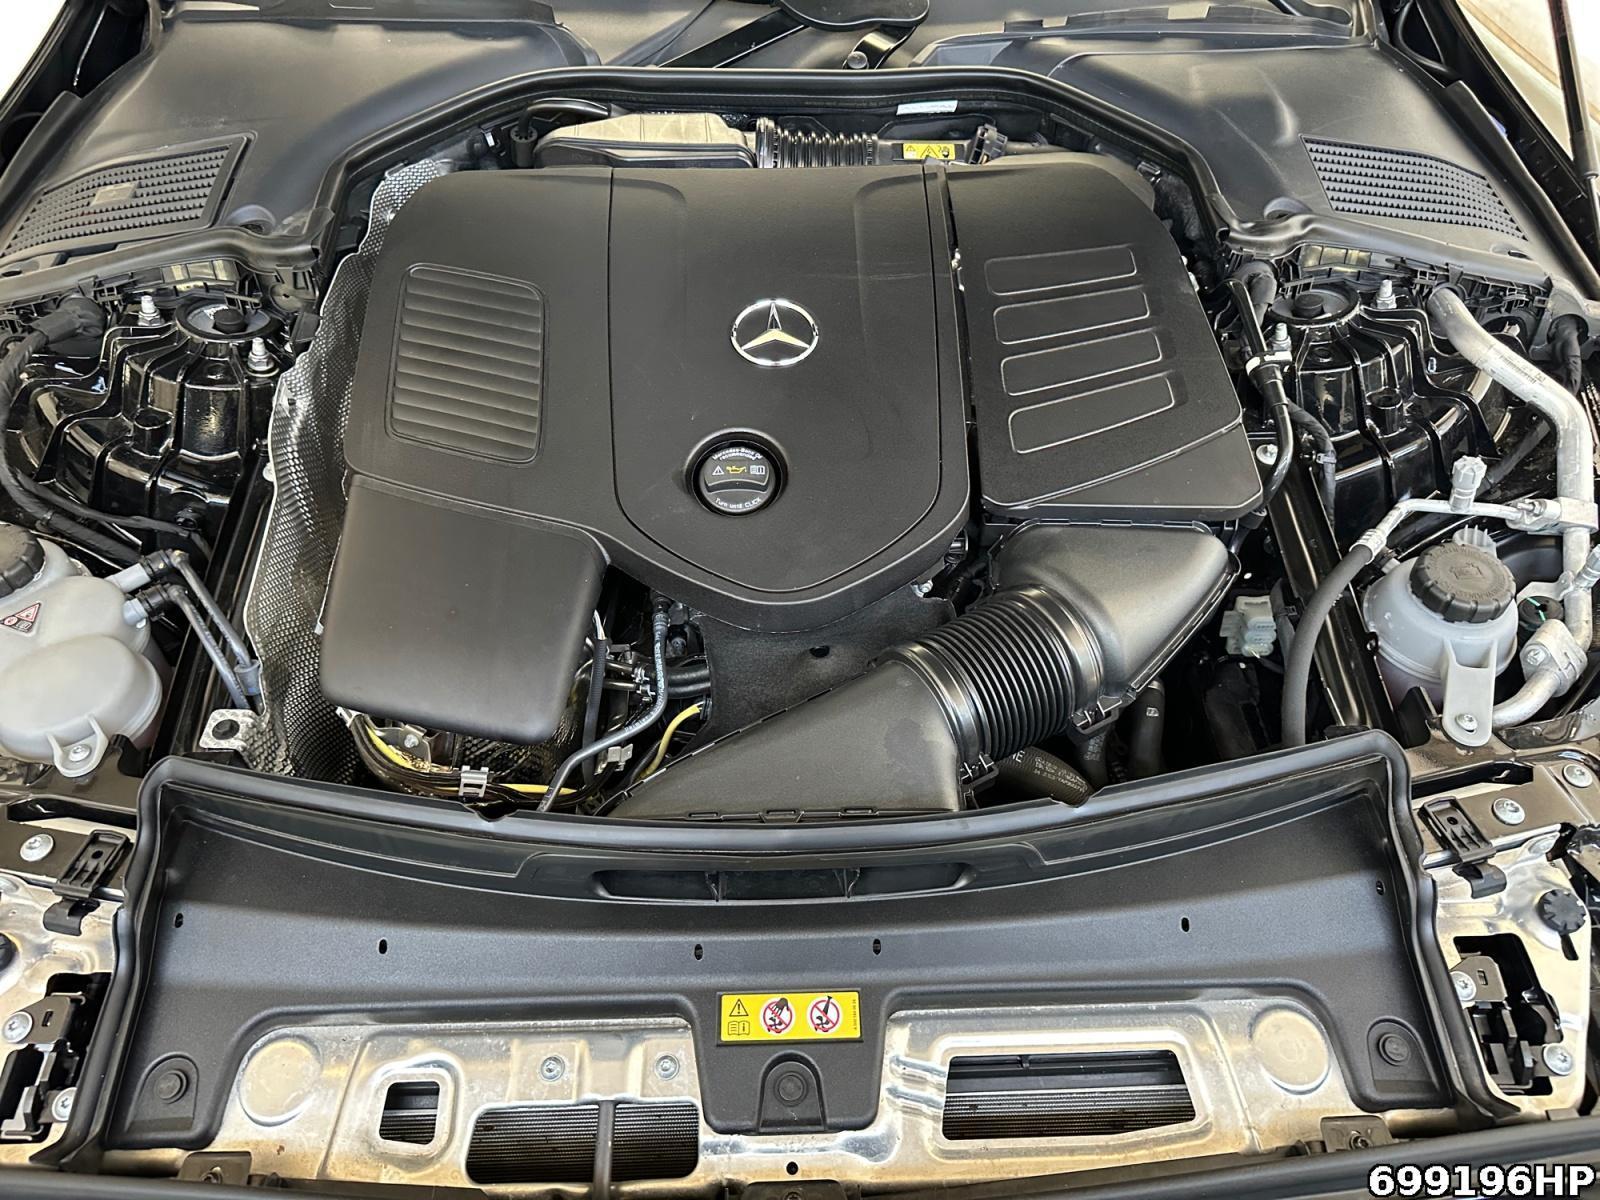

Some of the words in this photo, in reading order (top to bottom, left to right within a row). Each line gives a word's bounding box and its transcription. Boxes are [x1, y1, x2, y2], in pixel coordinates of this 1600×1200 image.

[712, 447, 754, 460] Mercedes-Benz
[715, 497, 728, 507] Turn
[744, 497, 762, 508] CLICK
